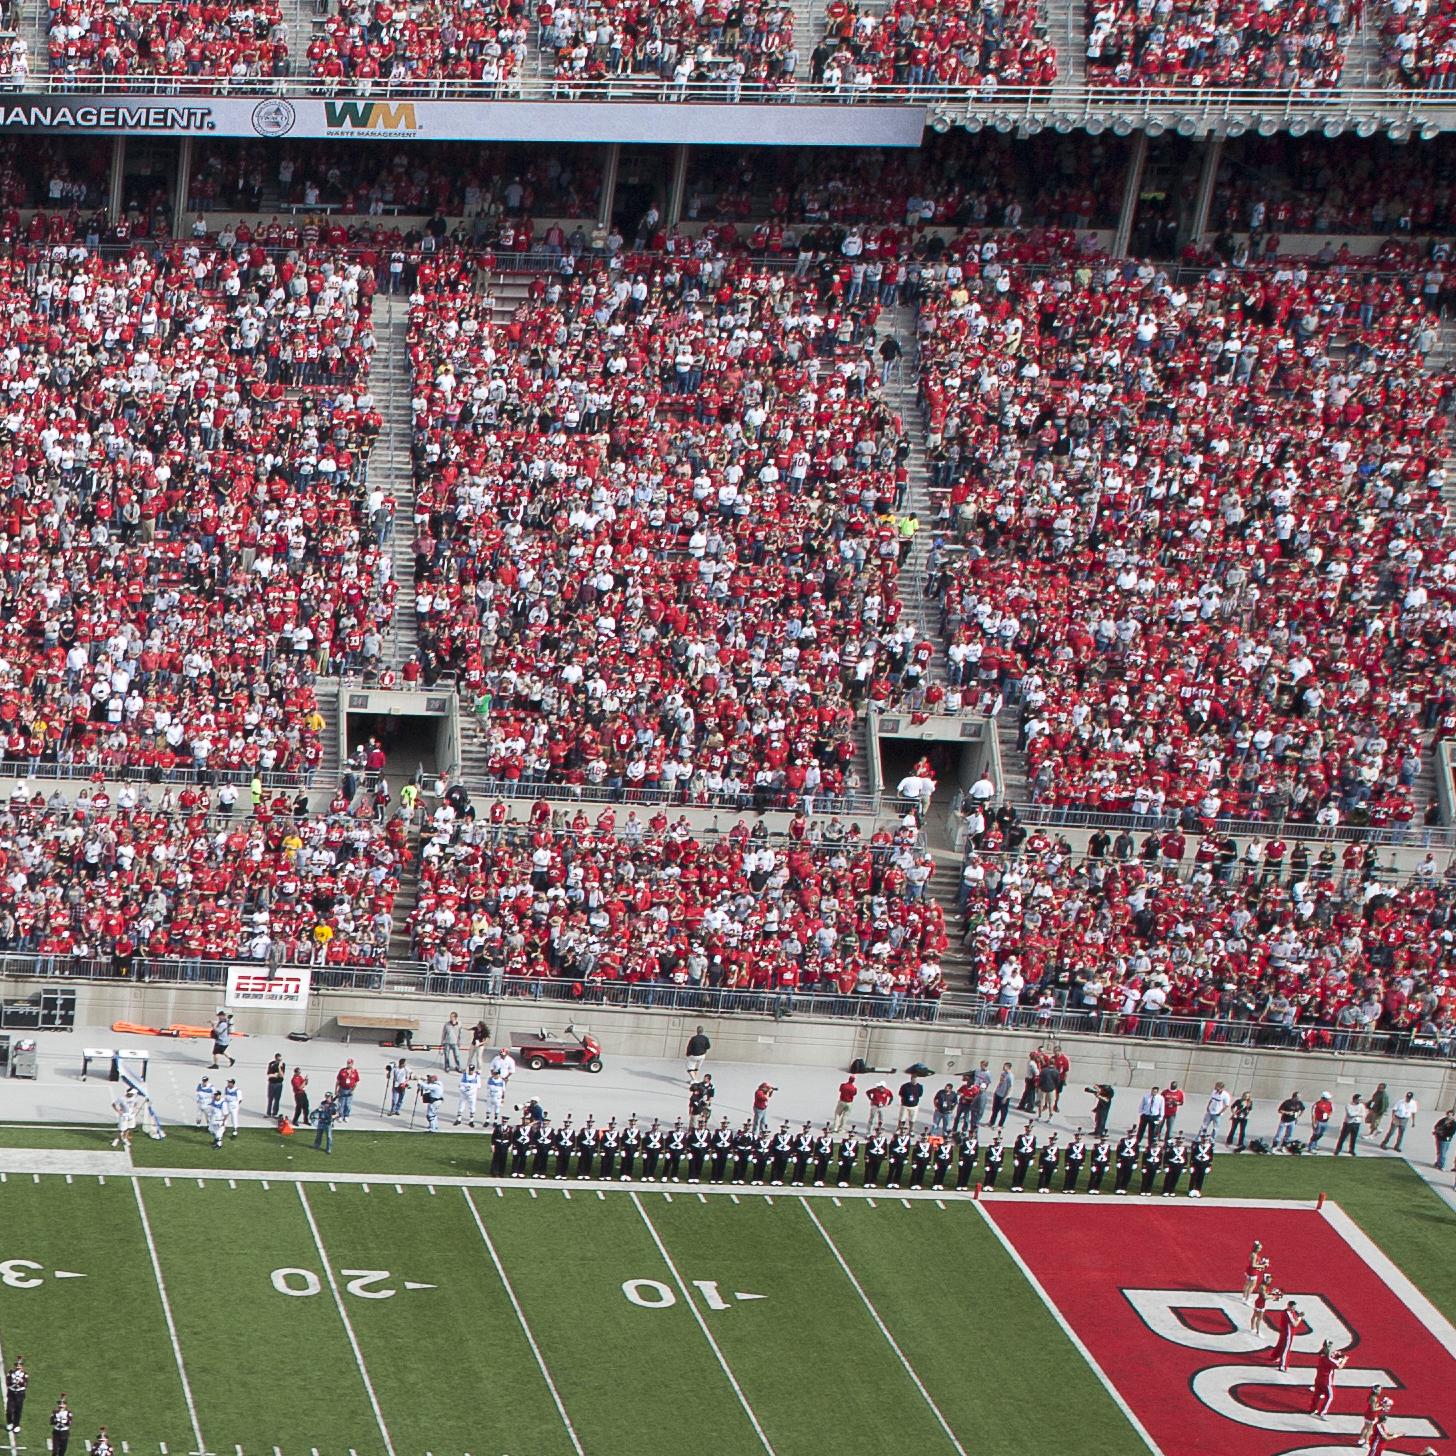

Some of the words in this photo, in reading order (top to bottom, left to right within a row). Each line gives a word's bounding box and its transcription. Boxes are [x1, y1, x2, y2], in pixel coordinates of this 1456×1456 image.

[324, 101, 417, 129] WM
[235, 975, 301, 994] ESPN
[269, 1266, 397, 1300] 20
[621, 1278, 732, 1311] 10
